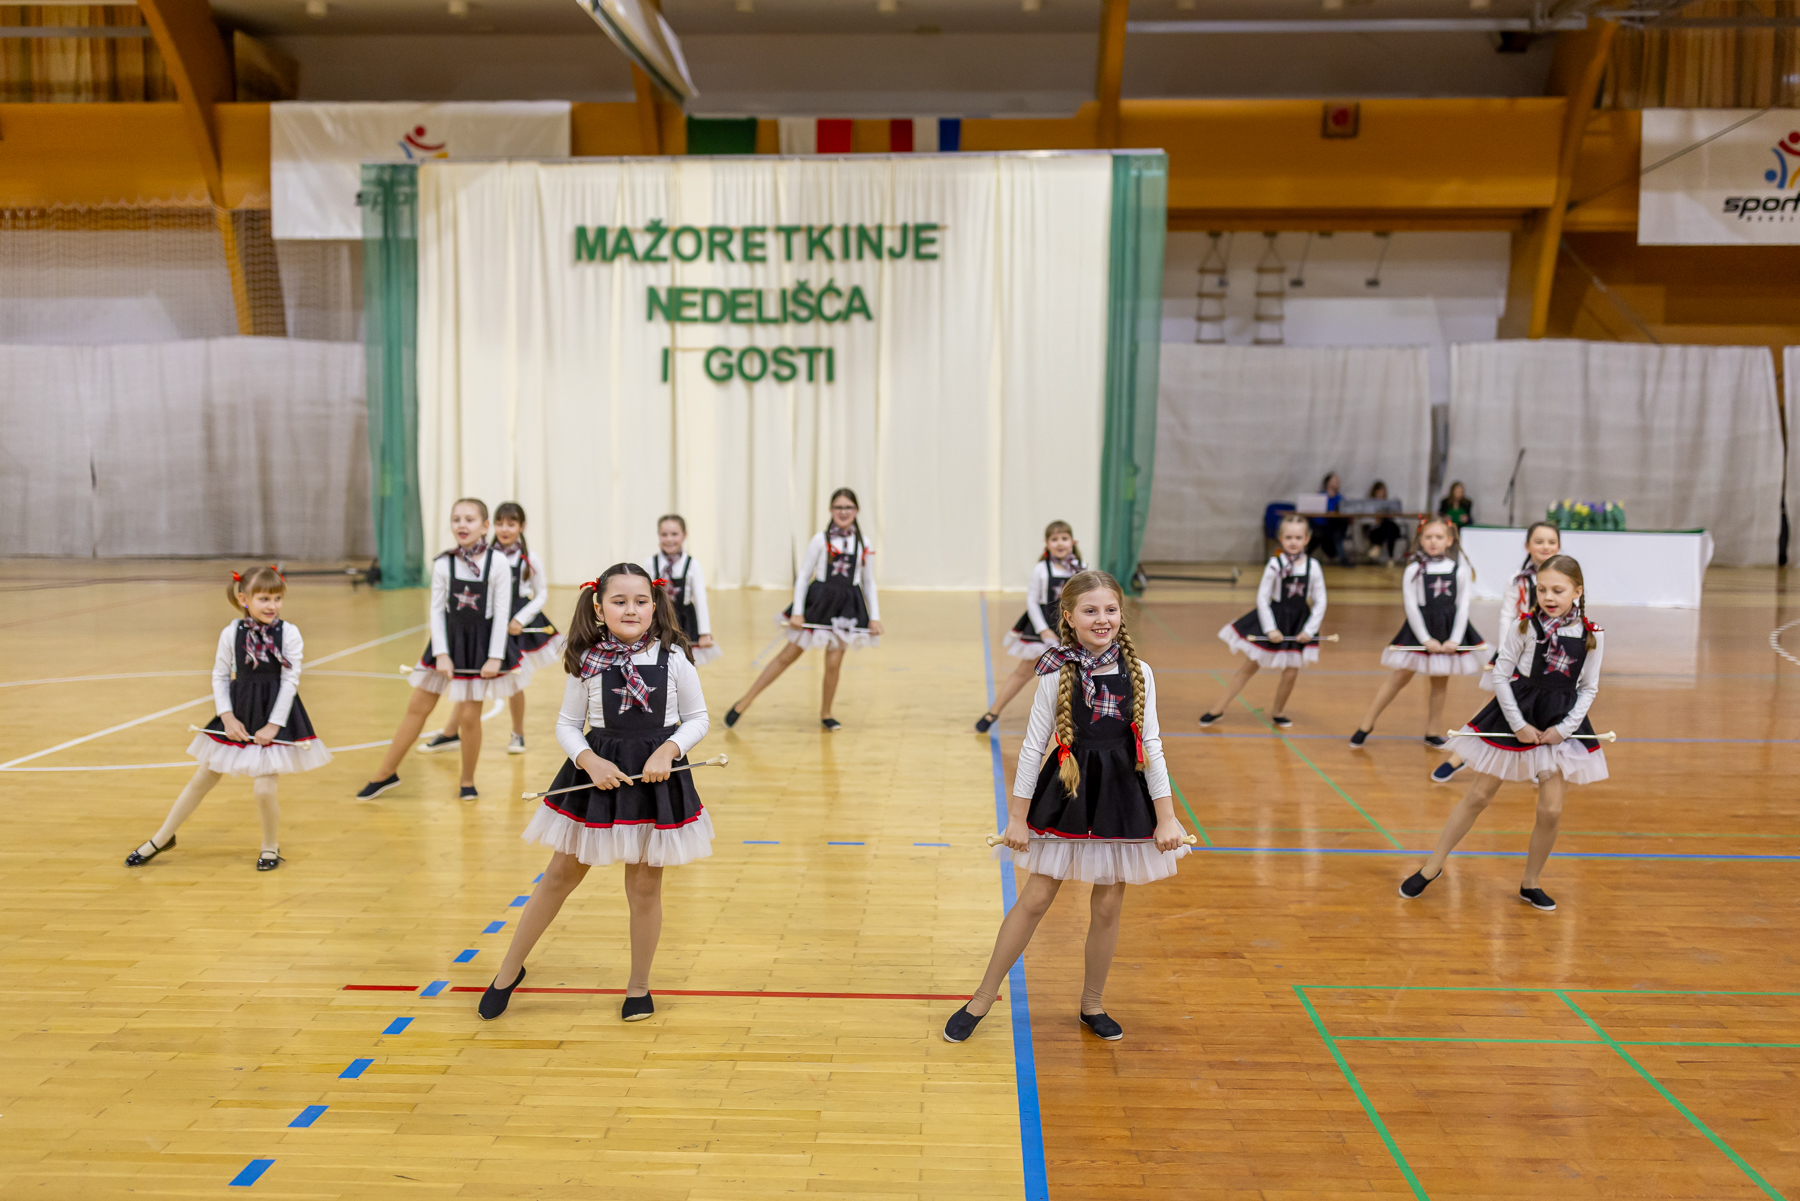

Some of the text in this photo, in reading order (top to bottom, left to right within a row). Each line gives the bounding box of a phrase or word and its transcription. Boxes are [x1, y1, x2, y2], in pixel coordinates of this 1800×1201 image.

[575, 219, 939, 262] MAŽORETKINJE
[646, 279, 873, 324] NEDELIŠĆA
[662, 346, 834, 383] I GOSTI
